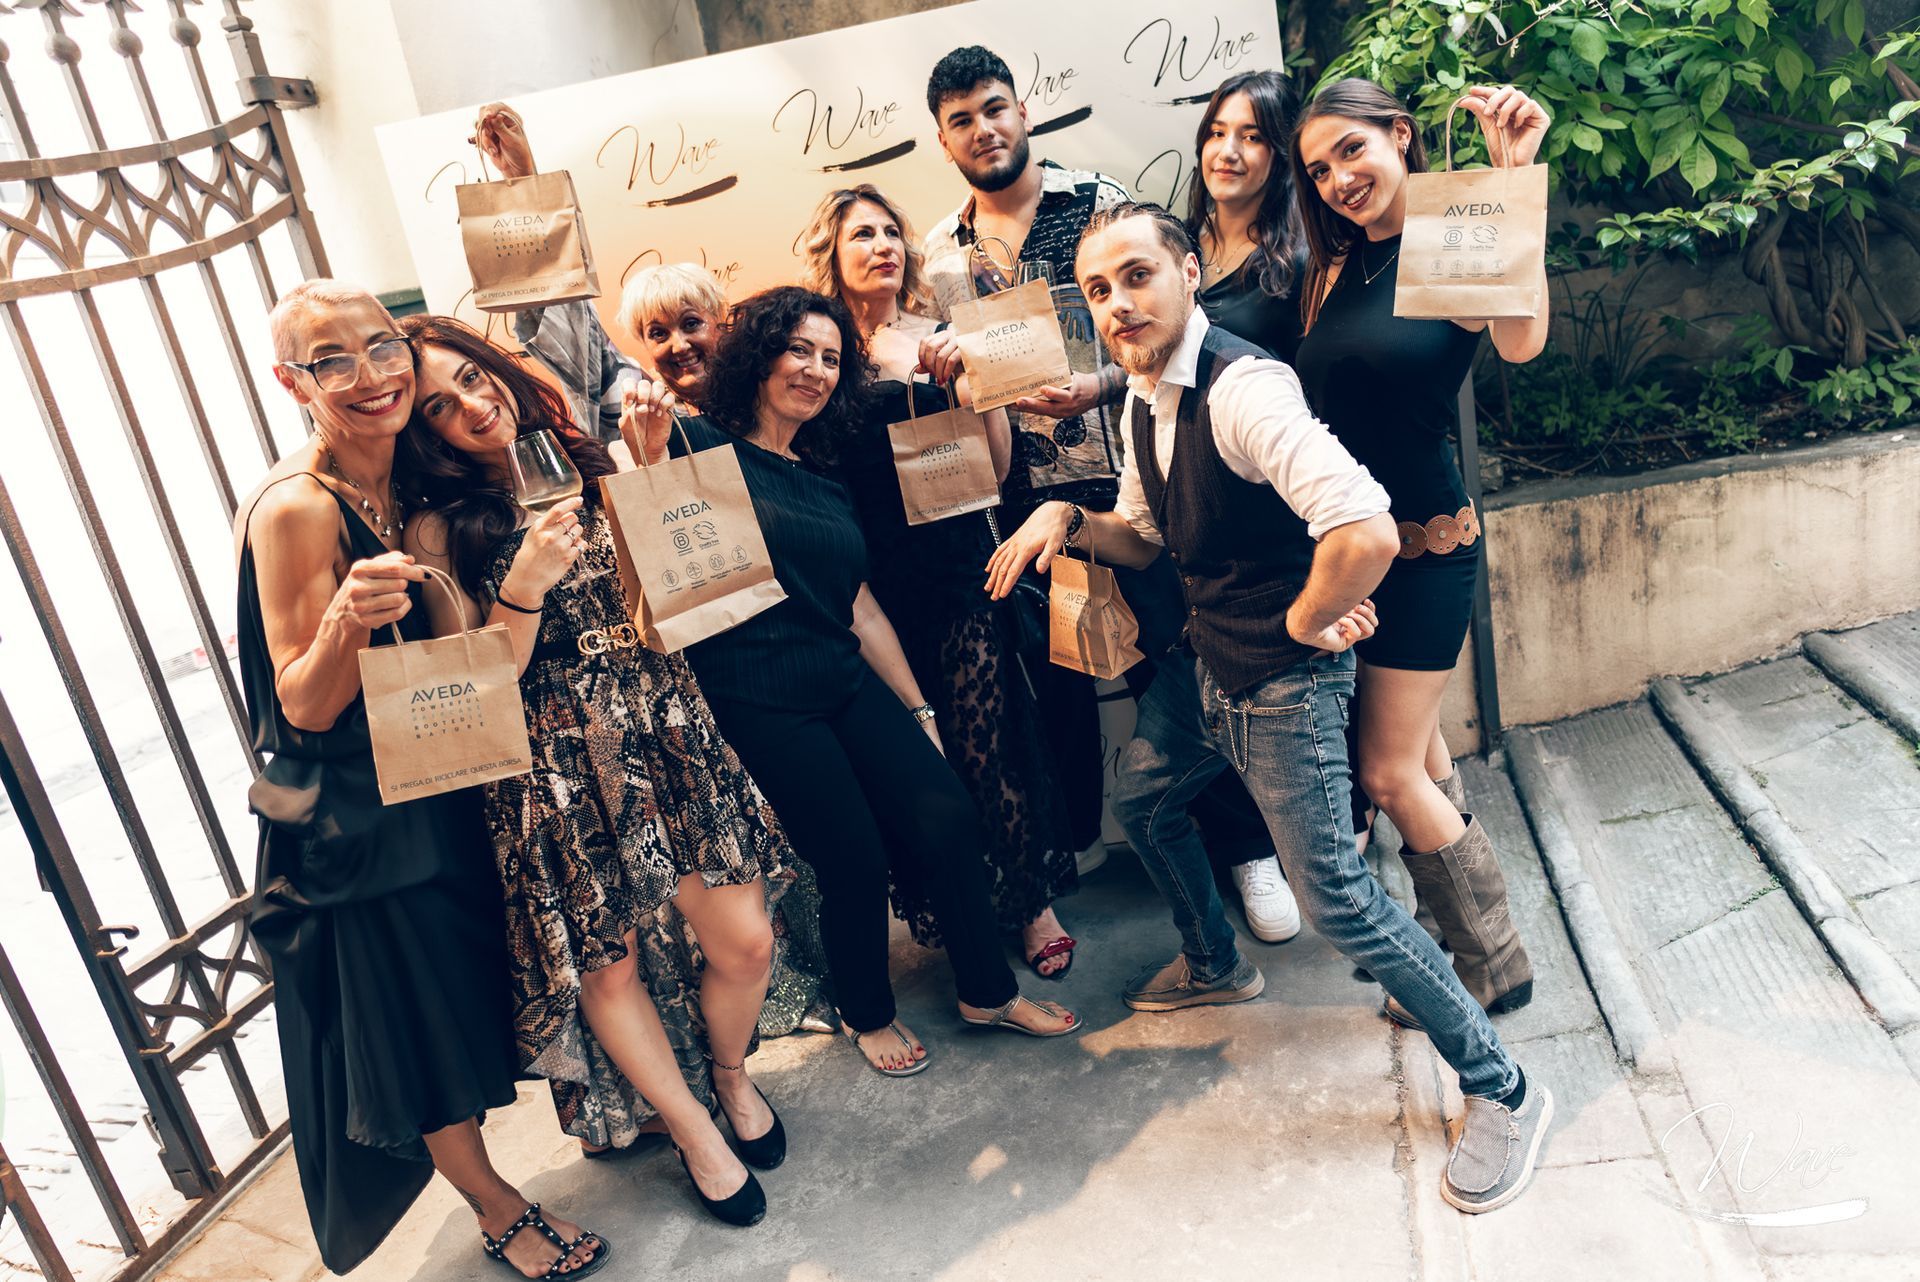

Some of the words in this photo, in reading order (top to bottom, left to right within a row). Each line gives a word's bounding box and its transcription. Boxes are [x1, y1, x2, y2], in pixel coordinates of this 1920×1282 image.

[1123, 16, 1259, 87] Wave
[1021, 52, 1078, 106] ave
[772, 87, 900, 154] Wave
[597, 123, 722, 190] Wave
[493, 214, 544, 229] AVEDA
[1443, 202, 1505, 218] AVEDA
[985, 321, 1029, 340] AVEDA
[920, 442, 961, 458] AVEDA
[662, 500, 712, 525] AVEDA
[1064, 591, 1092, 608] AVEDA
[411, 681, 477, 704] AVEDA
[400, 779, 424, 791] PREGA
[425, 777, 433, 785] DI
[470, 762, 498, 774] QUESTA
[498, 757, 522, 768] BORSA
